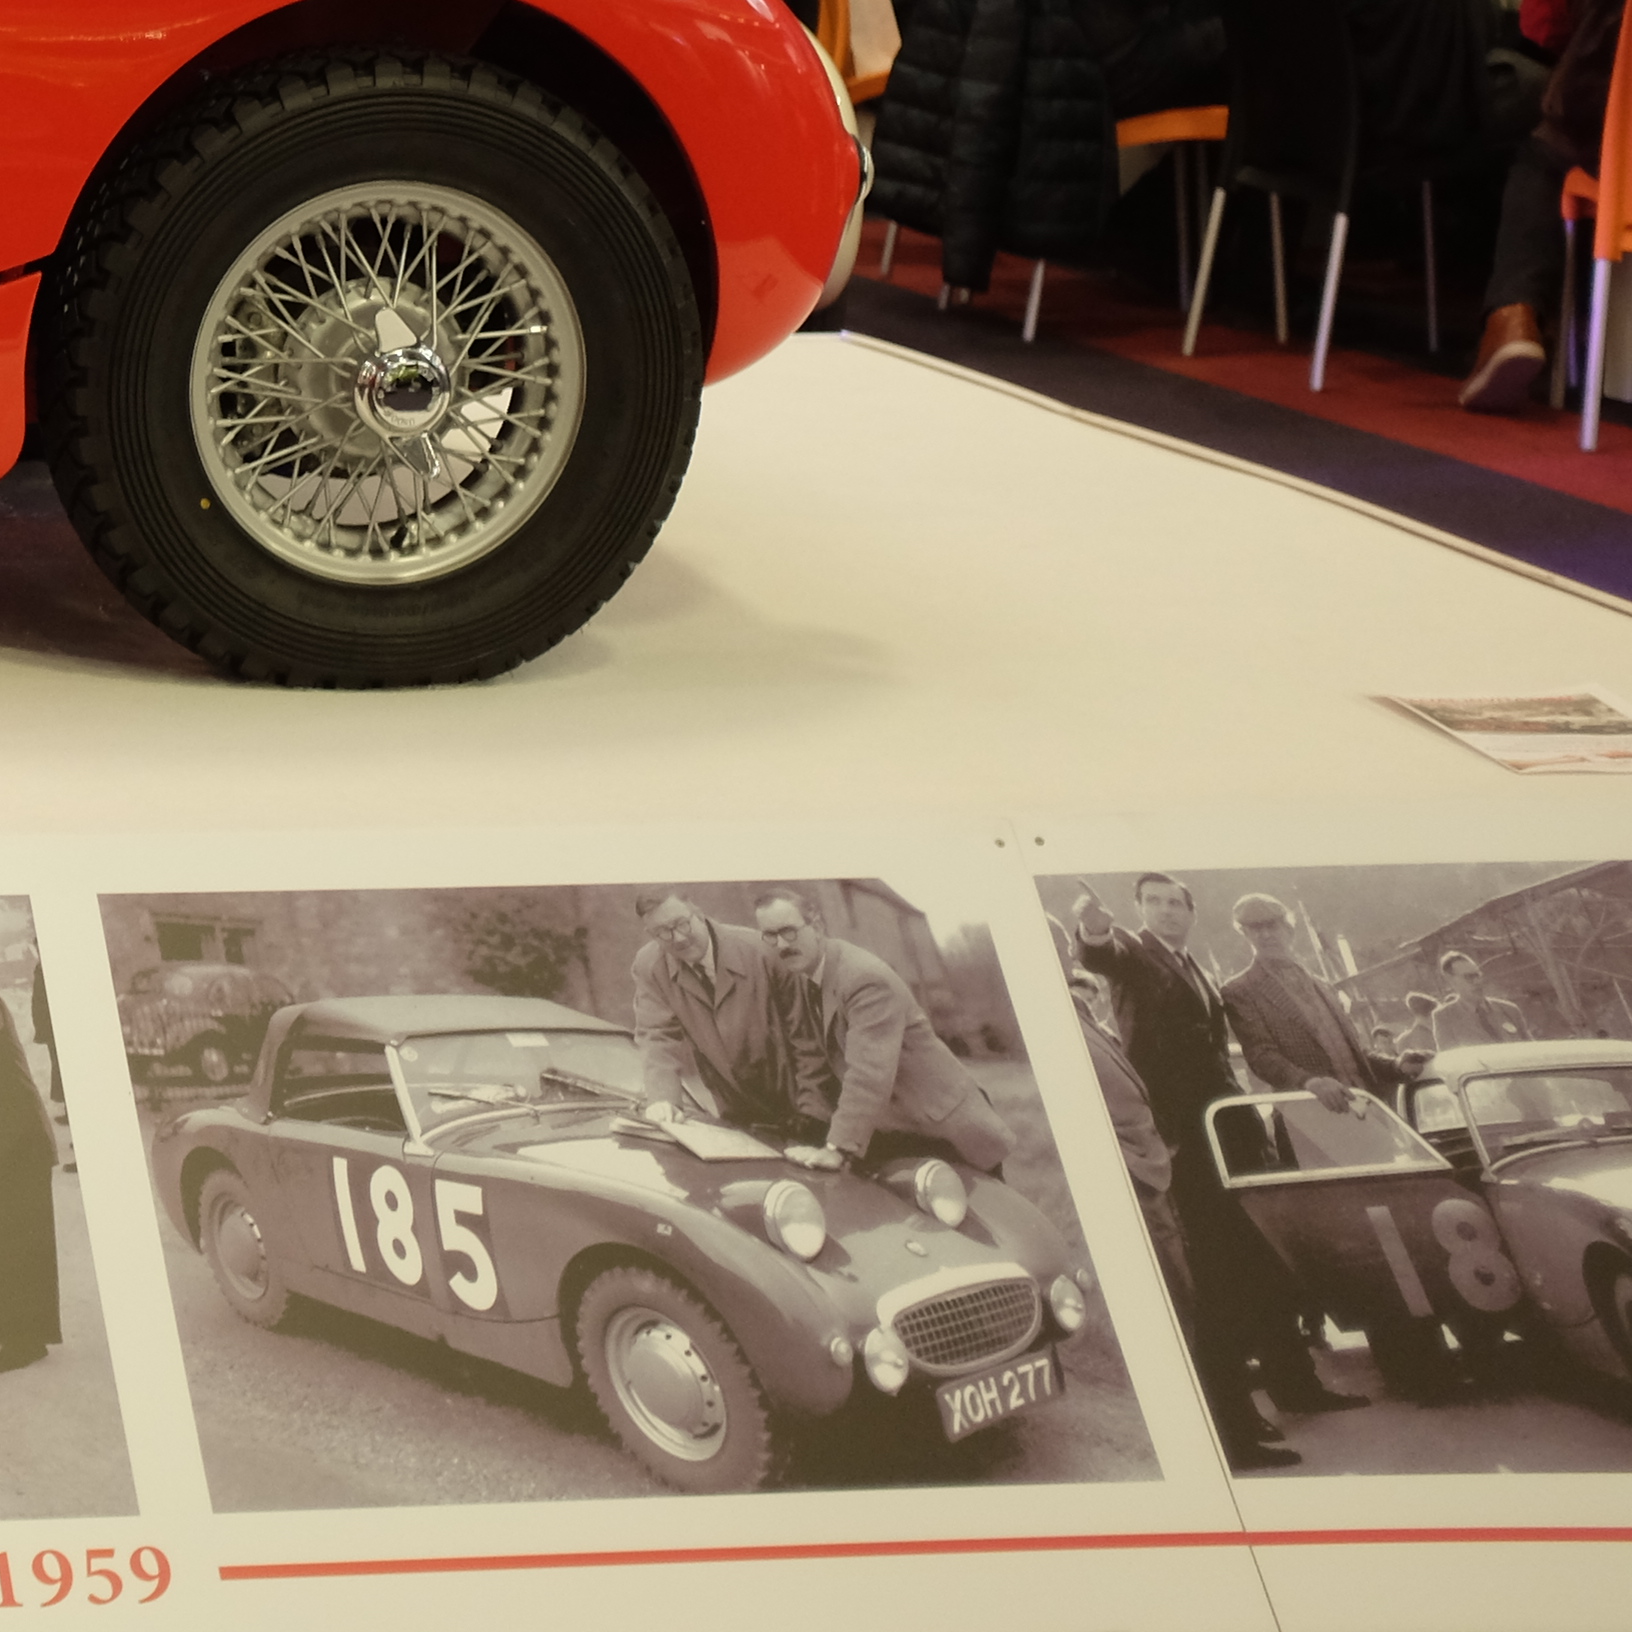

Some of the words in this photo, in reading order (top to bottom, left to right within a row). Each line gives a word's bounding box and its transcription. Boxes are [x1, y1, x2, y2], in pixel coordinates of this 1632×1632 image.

[332, 1155, 498, 1311] 185
[944, 1377, 1004, 1435] XOH
[1002, 1358, 1052, 1410] 277
